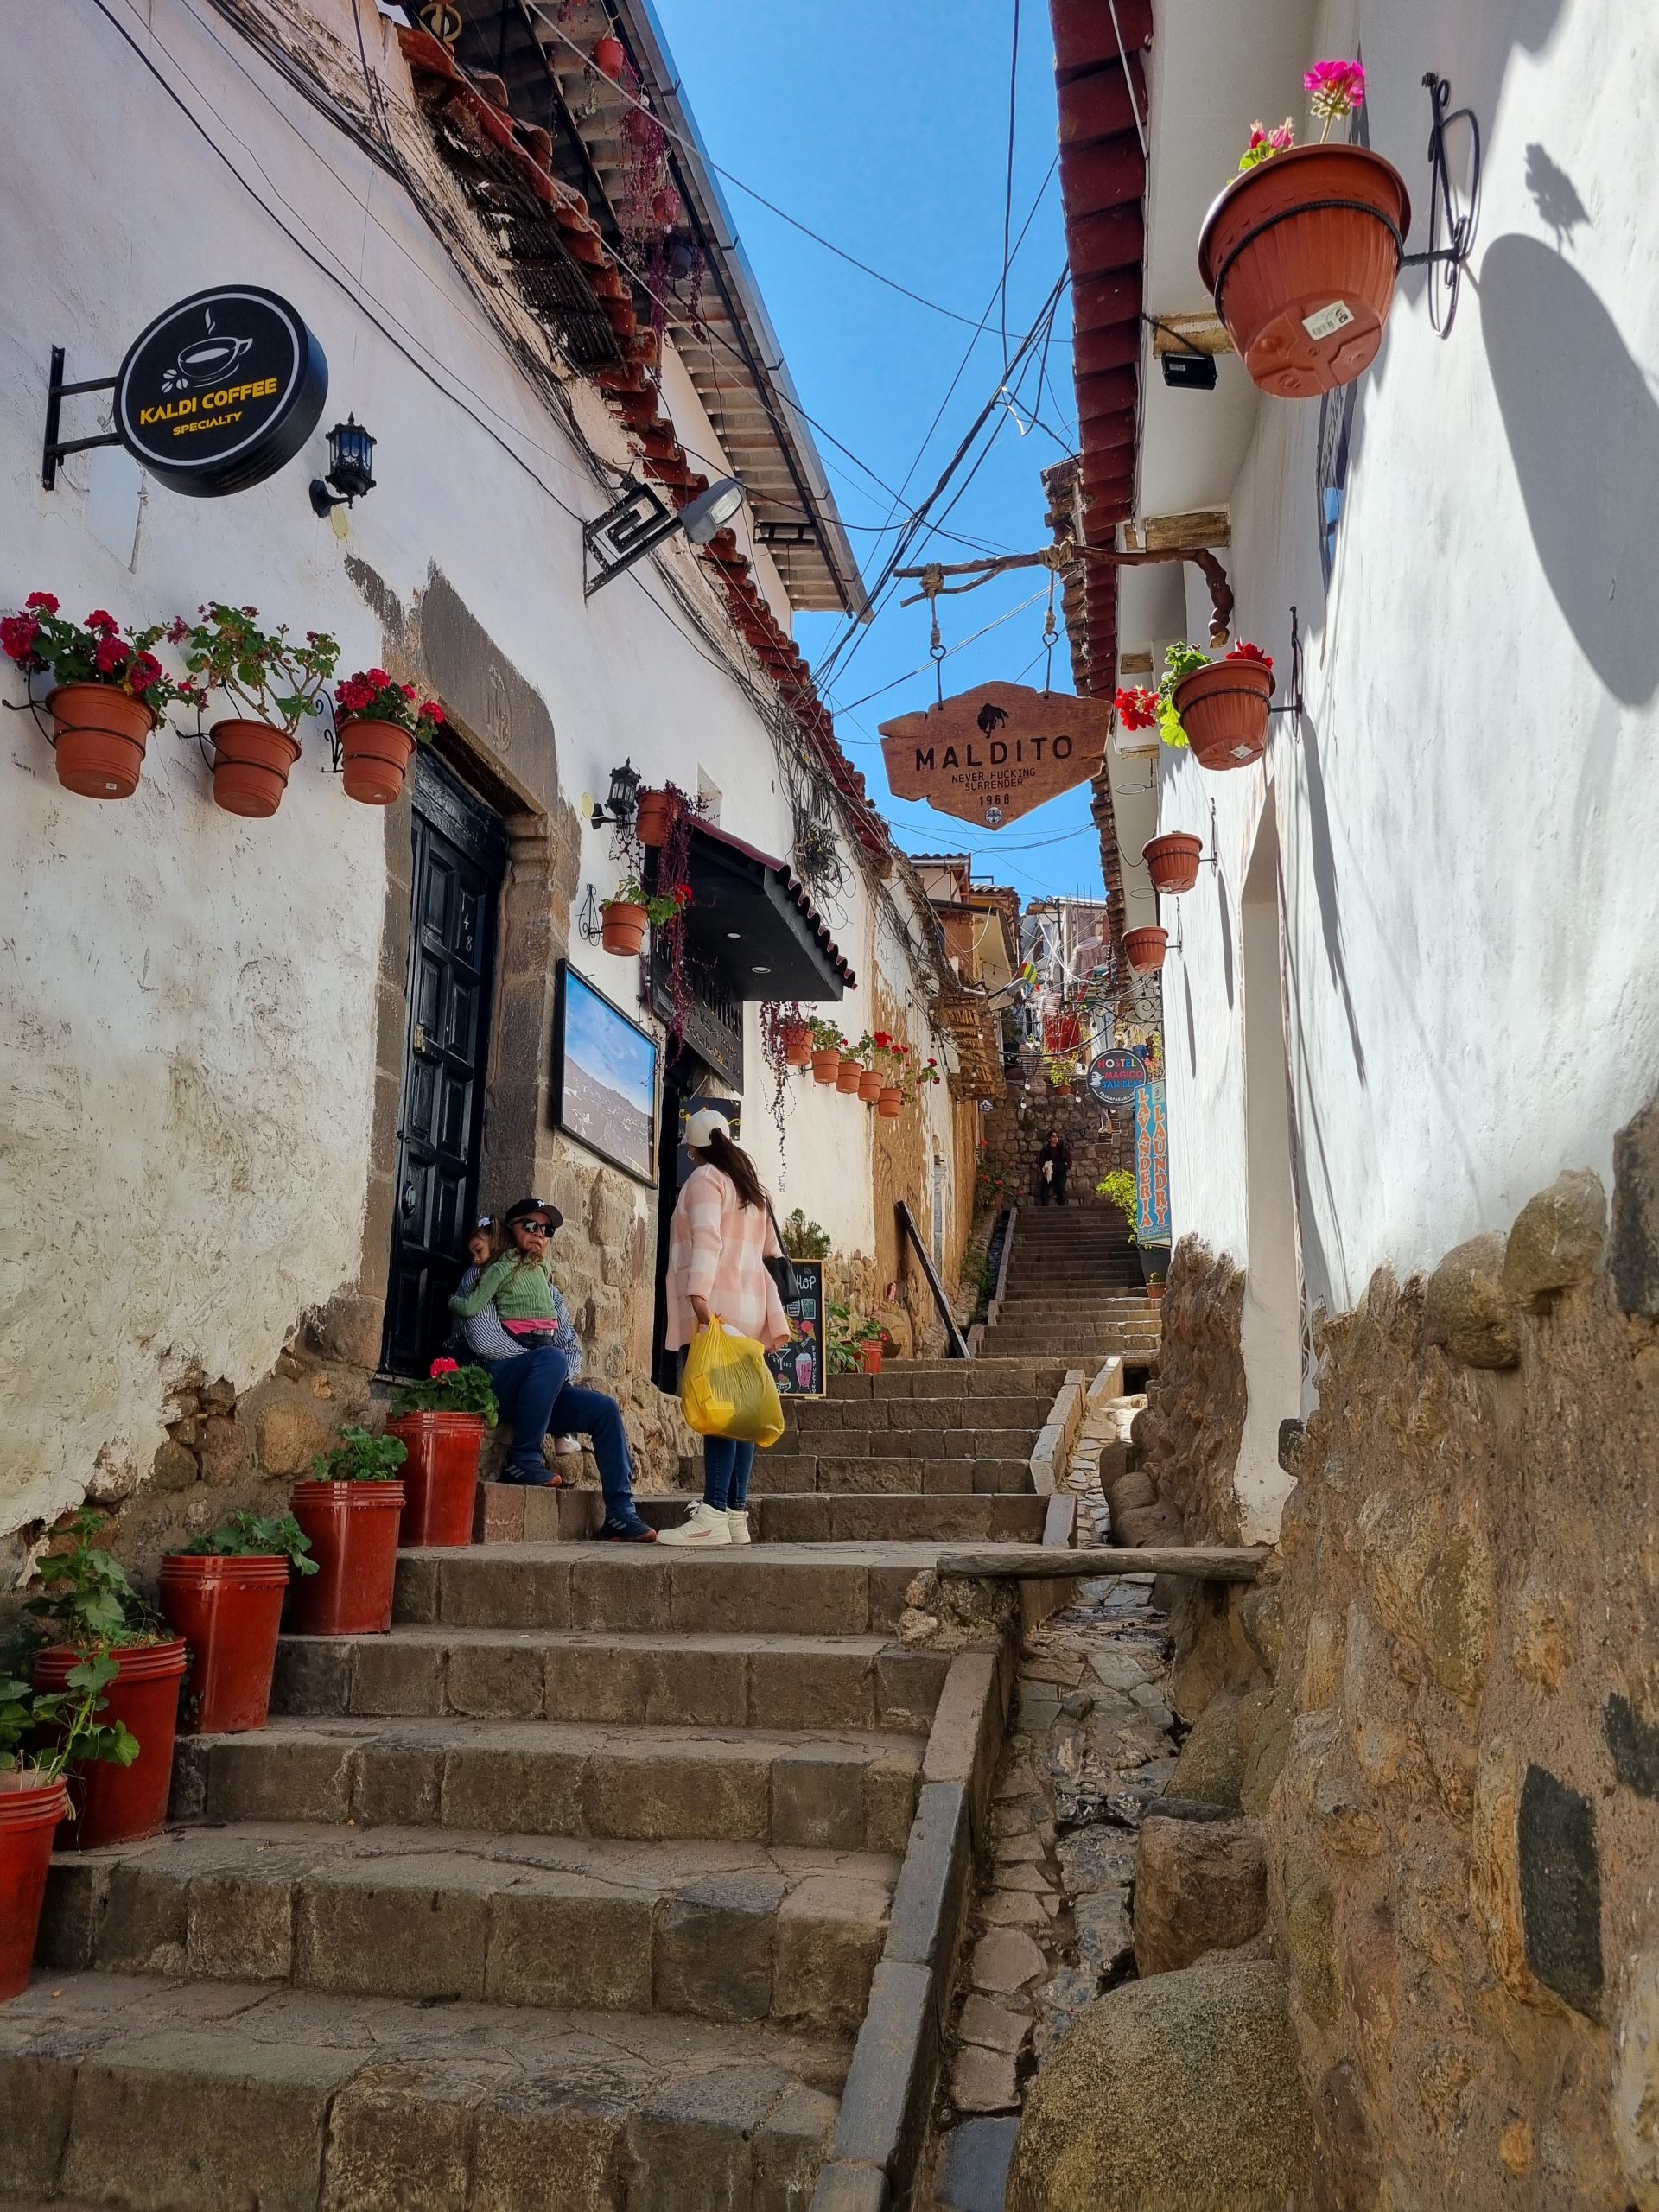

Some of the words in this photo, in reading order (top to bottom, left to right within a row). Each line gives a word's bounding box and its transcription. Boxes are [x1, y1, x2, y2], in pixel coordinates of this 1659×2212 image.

[140, 397, 197, 425] KALDI
[201, 377, 277, 410] COFFEE
[172, 410, 243, 436] SPECIALTY
[915, 734, 1073, 772] MALDITO
[951, 772, 984, 784] NEVER
[990, 767, 1036, 779] FUCKING
[964, 778, 1023, 791] SURRENDER
[979, 793, 1010, 806] 1968
[1097, 1058, 1136, 1068] HOSTEL
[1138, 1088, 1153, 1228] LAVANDERIA
[1153, 1105, 1167, 1224] LAUNDRY
[796, 1275, 817, 1290] HOP
